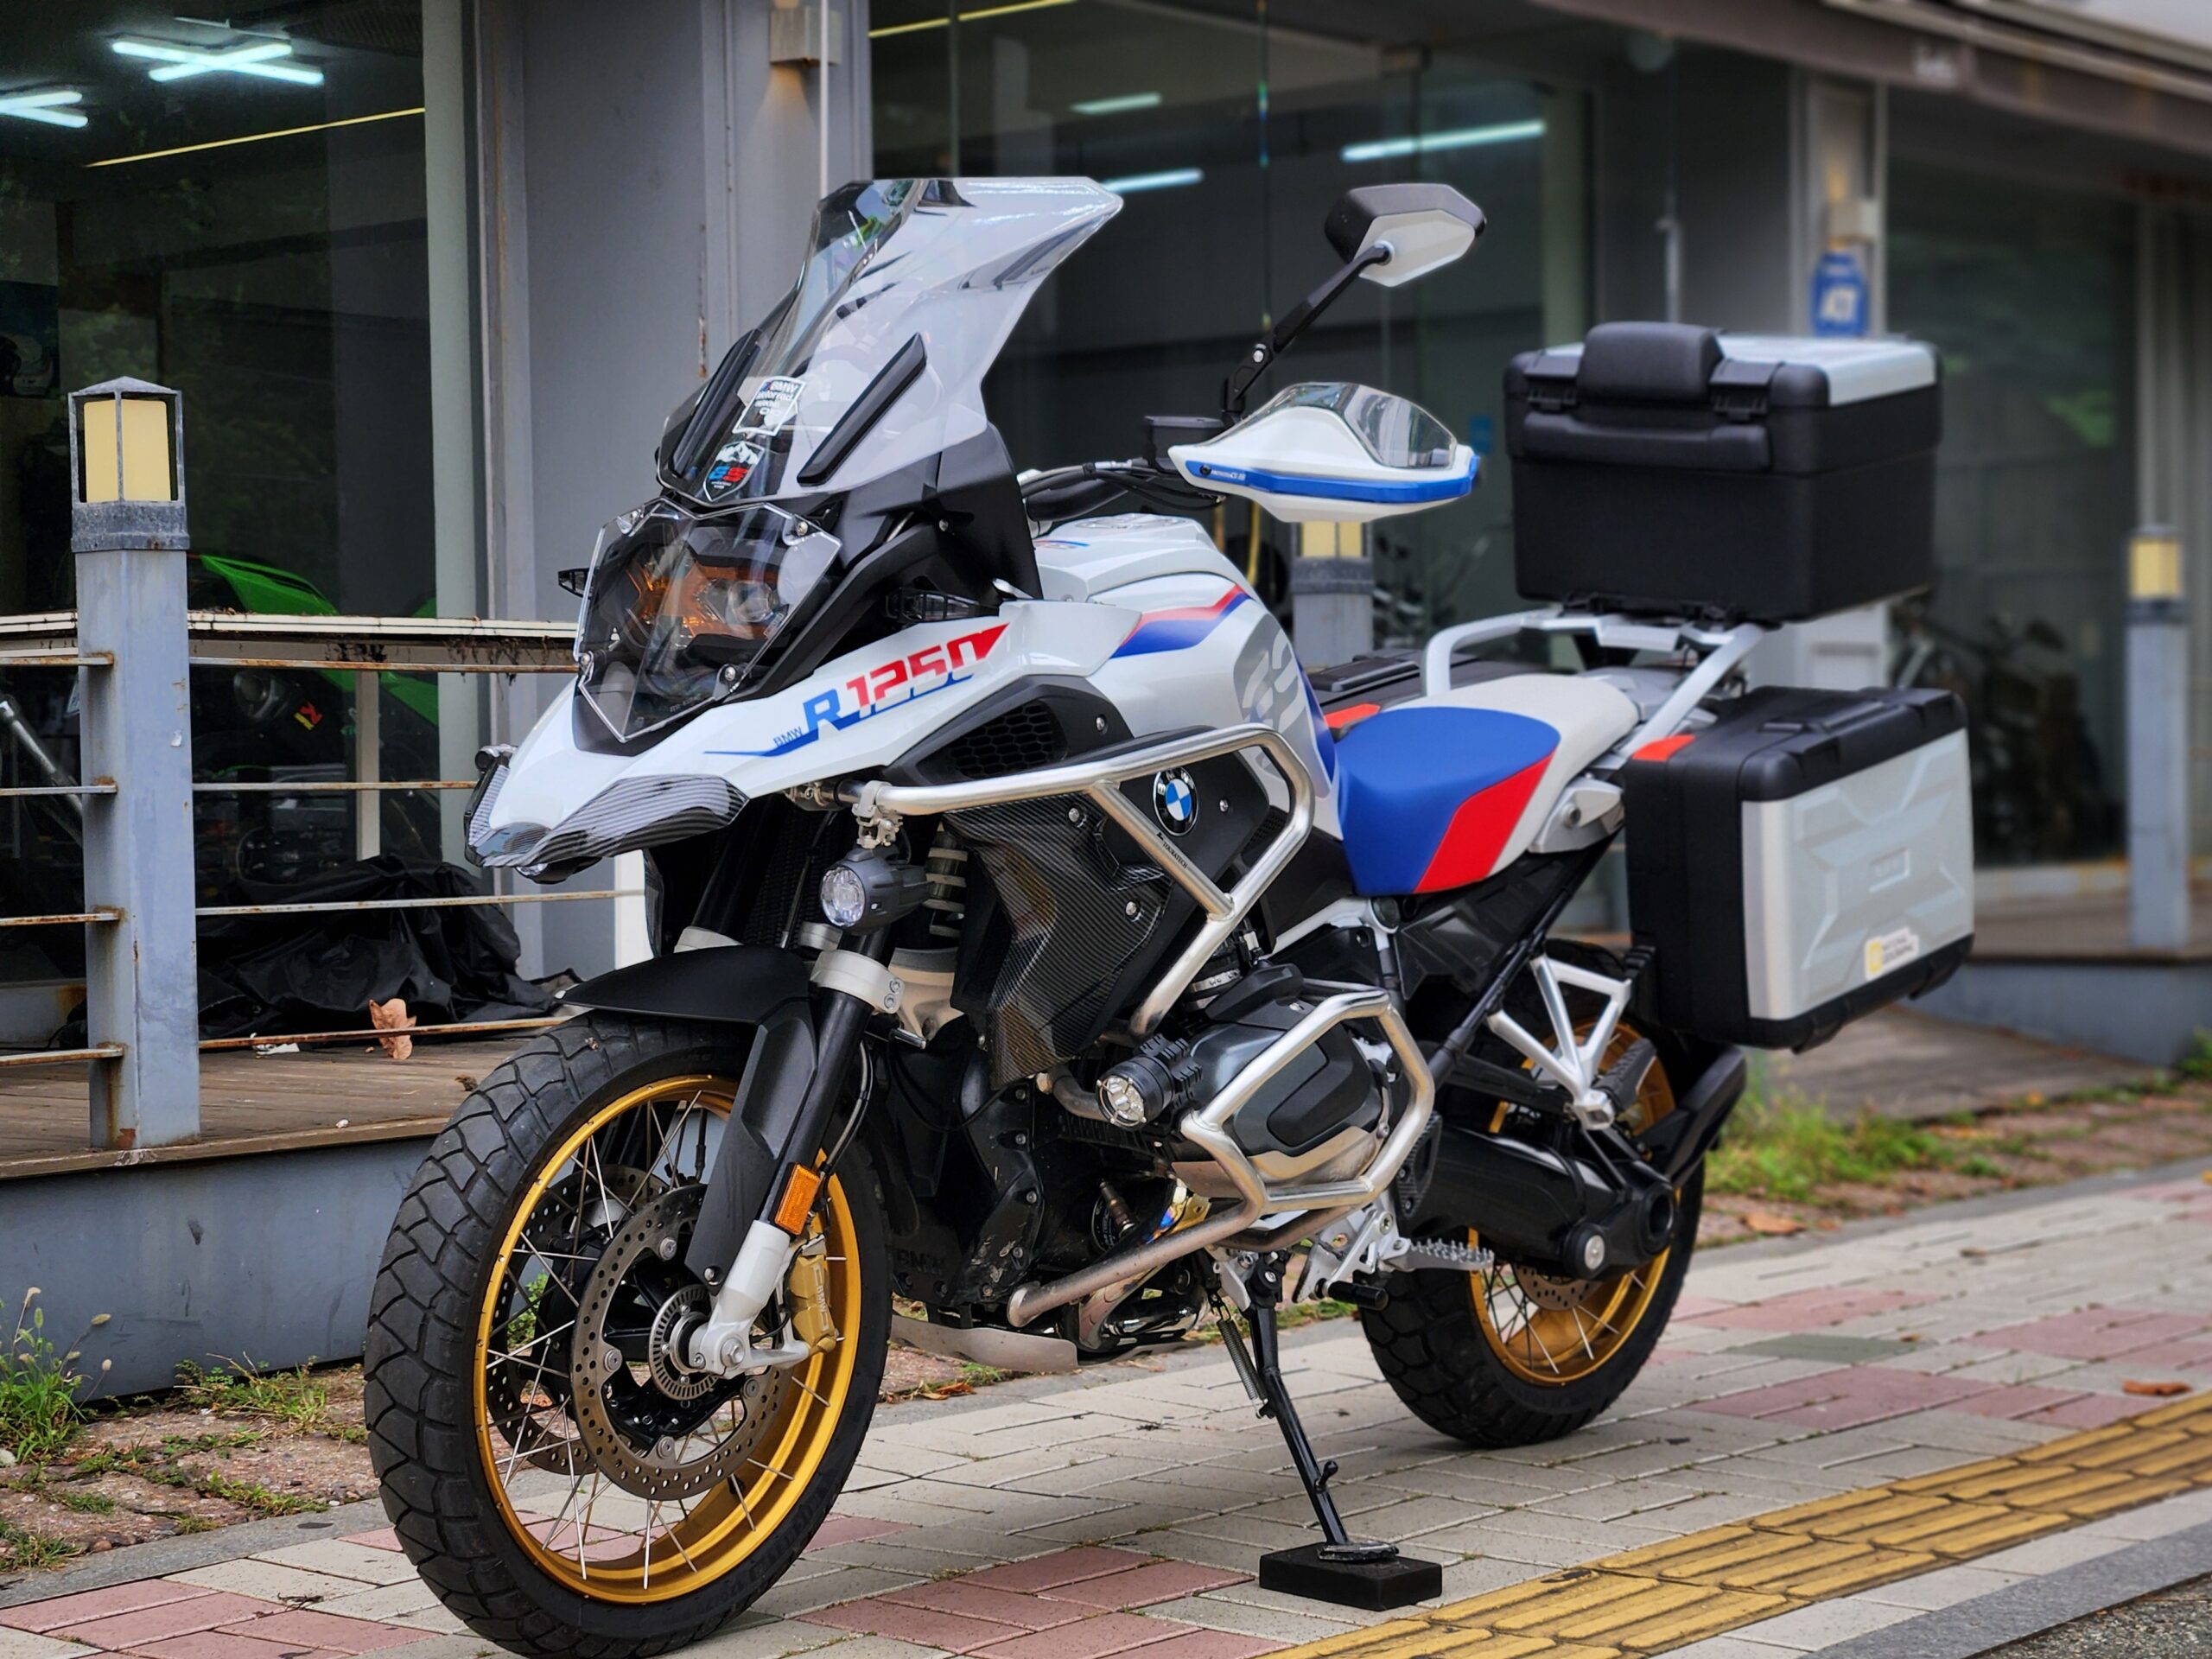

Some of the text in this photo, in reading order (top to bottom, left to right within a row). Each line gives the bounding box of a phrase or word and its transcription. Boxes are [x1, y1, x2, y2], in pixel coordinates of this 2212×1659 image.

[770, 381, 799, 393] BMW
[772, 726, 804, 747] BMW
[1162, 842, 1189, 870] TOURATECH
